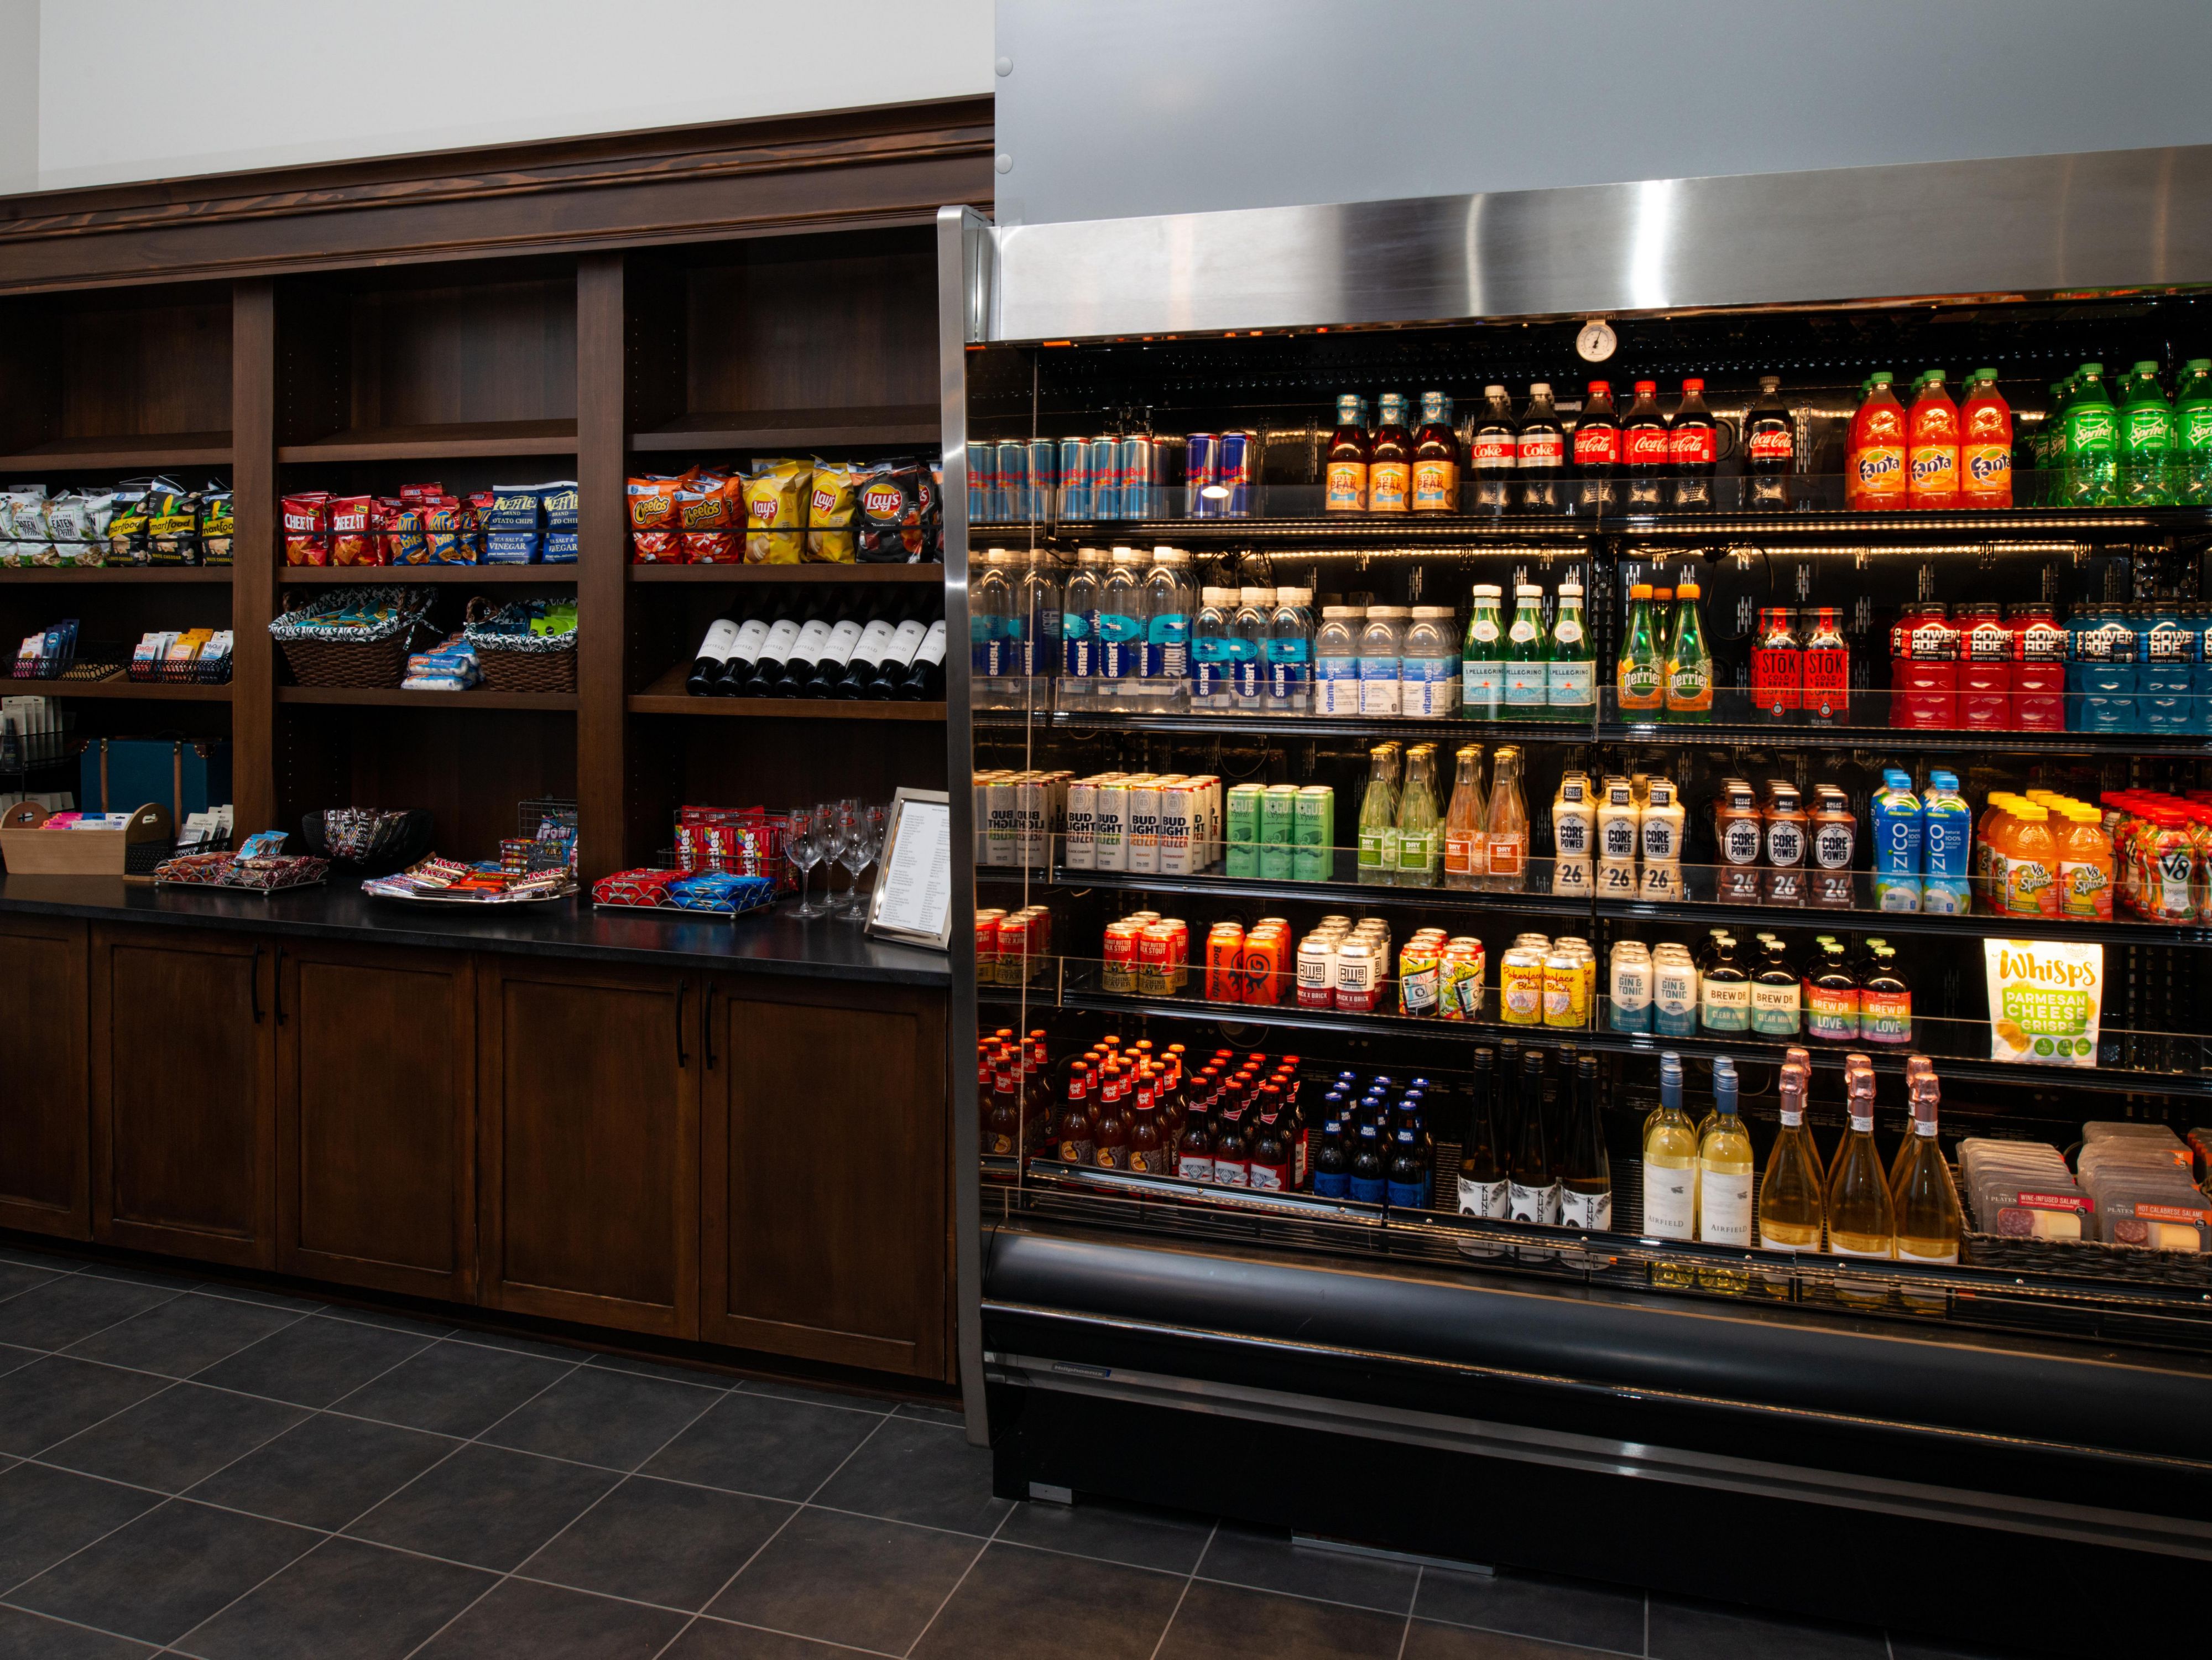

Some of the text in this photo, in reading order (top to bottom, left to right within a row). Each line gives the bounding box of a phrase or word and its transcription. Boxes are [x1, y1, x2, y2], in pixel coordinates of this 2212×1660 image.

[2077, 427, 2110, 440] Sprite
[2131, 426, 2164, 439] Sprite
[1474, 445, 1503, 457] Coke
[1523, 444, 1554, 456] Coke
[1129, 467, 1146, 476] Bull
[1859, 455, 1900, 481] Fanta
[1911, 454, 1952, 481] Fanta
[1971, 454, 2011, 480] Fanta
[1331, 480, 1356, 489] PEAK
[1376, 482, 1402, 491] PEAK
[1417, 480, 1443, 488] PEAK
[813, 490, 836, 511] Lay's
[866, 492, 900, 512] Lay's
[634, 497, 670, 523] Cheetos
[684, 501, 721, 527] Cheetos
[753, 499, 776, 519] Lay's
[51, 519, 74, 529] EATEN
[202, 522, 233, 534] martfoo
[1912, 640, 1939, 651] ADE
[1973, 641, 2001, 652] ADE
[2025, 641, 2054, 652] ADE
[2151, 642, 2181, 653] ADE
[1076, 641, 1088, 677] smart
[1108, 641, 1118, 678] smart
[1199, 663, 1209, 695] smart
[1245, 663, 1255, 696] smart
[1423, 659, 1433, 715] vitaminwater
[1264, 800, 1294, 813] ROGUE
[1295, 800, 1324, 816] ROGUE
[1068, 813, 1092, 822] BUD
[1132, 815, 1156, 825] BUD
[1163, 816, 1187, 826] BUD
[1066, 822, 1096, 832] LIGHT
[1130, 825, 1160, 834] LIGHT
[1560, 825, 1583, 839] CORE
[1066, 832, 1094, 844] SELTZER
[1130, 835, 1158, 847] SELTZER
[1608, 830, 1632, 843] CORE
[1646, 830, 1669, 844] CORE
[1731, 832, 1756, 846] CORE
[1773, 834, 1797, 847] CORE
[1561, 839, 1583, 849] POWER
[1608, 843, 1631, 853] POWER
[1647, 843, 1669, 853] POWER
[1822, 837, 1848, 850] CORE
[1731, 846, 1755, 856] POWER
[1773, 847, 1797, 858] POWER
[1823, 850, 1847, 860] POWER
[434, 857, 469, 871] TWIX
[2031, 863, 2043, 876] V8
[2159, 852, 2190, 881] V8
[525, 867, 562, 881] TWIX
[1562, 865, 1581, 883] 26
[1609, 868, 1629, 887] 26
[2085, 865, 2099, 878] V8
[1649, 870, 1667, 888] 26
[1734, 873, 1754, 892] 26
[2020, 875, 2053, 892] Splash
[2075, 876, 2108, 894] Splash
[1992, 949, 2096, 987] Whisps
[1517, 982, 1540, 990] Blonde
[1547, 982, 1571, 993] Blonde
[1619, 977, 1643, 987] GIN &
[1662, 980, 1686, 990] GIN &
[1618, 986, 1644, 995] TONIC
[1661, 989, 1687, 999] TONIC
[1711, 990, 1736, 1000] BREW
[1757, 993, 1782, 1003] BREW
[2006, 992, 2085, 1006] PARMESAN
[1813, 1000, 1837, 1010] BREW
[1870, 1003, 1895, 1014] BREW
[1712, 1010, 1745, 1019] CLEAR MIND
[2007, 1003, 2085, 1020] CHEESE
[1758, 1013, 1792, 1023] CLEAR MIND
[1817, 1017, 1842, 1030] LOVE
[1876, 1020, 1901, 1033] LOVE
[2021, 1019, 2075, 1032] CRISPS
[2021, 1194, 2058, 1204] WINE-INFUSED
[2150, 1206, 2181, 1216] CALABRESE
[2182, 1210, 2204, 1218] SALAME
[1648, 1215, 1684, 1227] AIRFIELD
[1711, 1223, 1748, 1234] AIRFIELD
